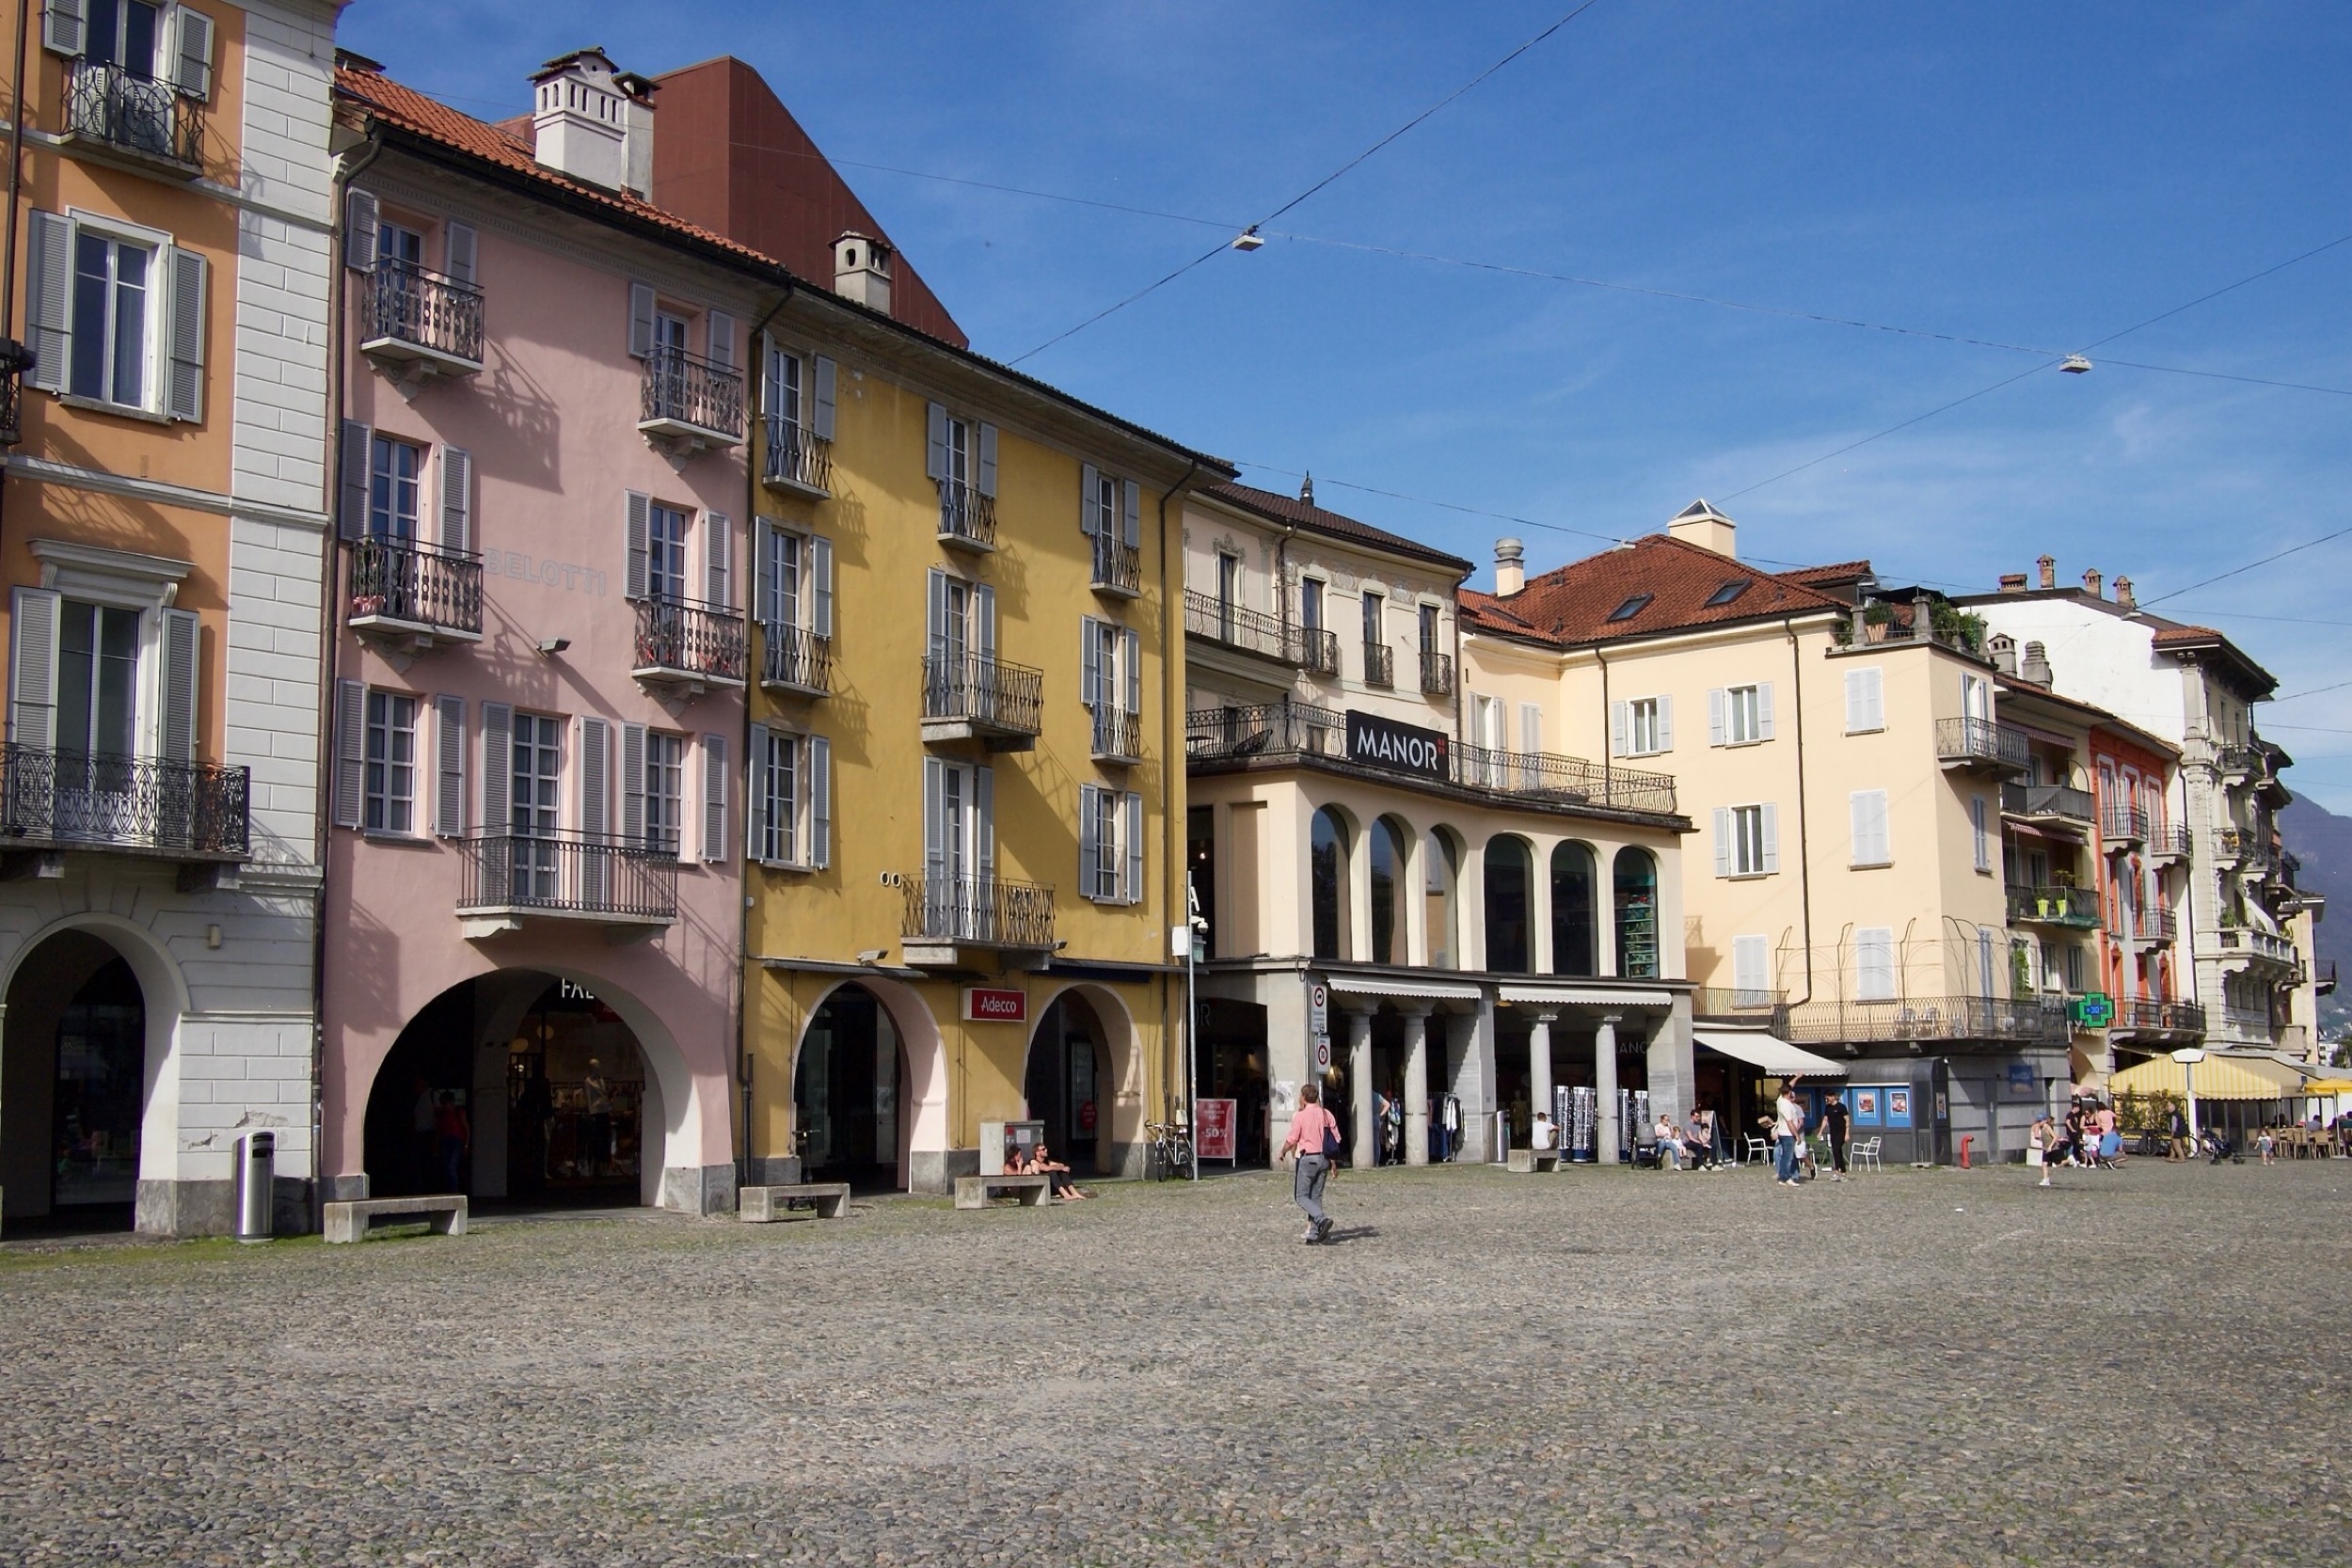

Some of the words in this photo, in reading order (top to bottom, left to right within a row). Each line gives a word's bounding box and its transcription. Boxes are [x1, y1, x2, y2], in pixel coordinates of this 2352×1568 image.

[484, 546, 607, 596] BELOTTI
[1357, 726, 1438, 770] MANOR
[981, 996, 1016, 1013] Adecco
[1200, 1128, 1227, 1138] -50%
